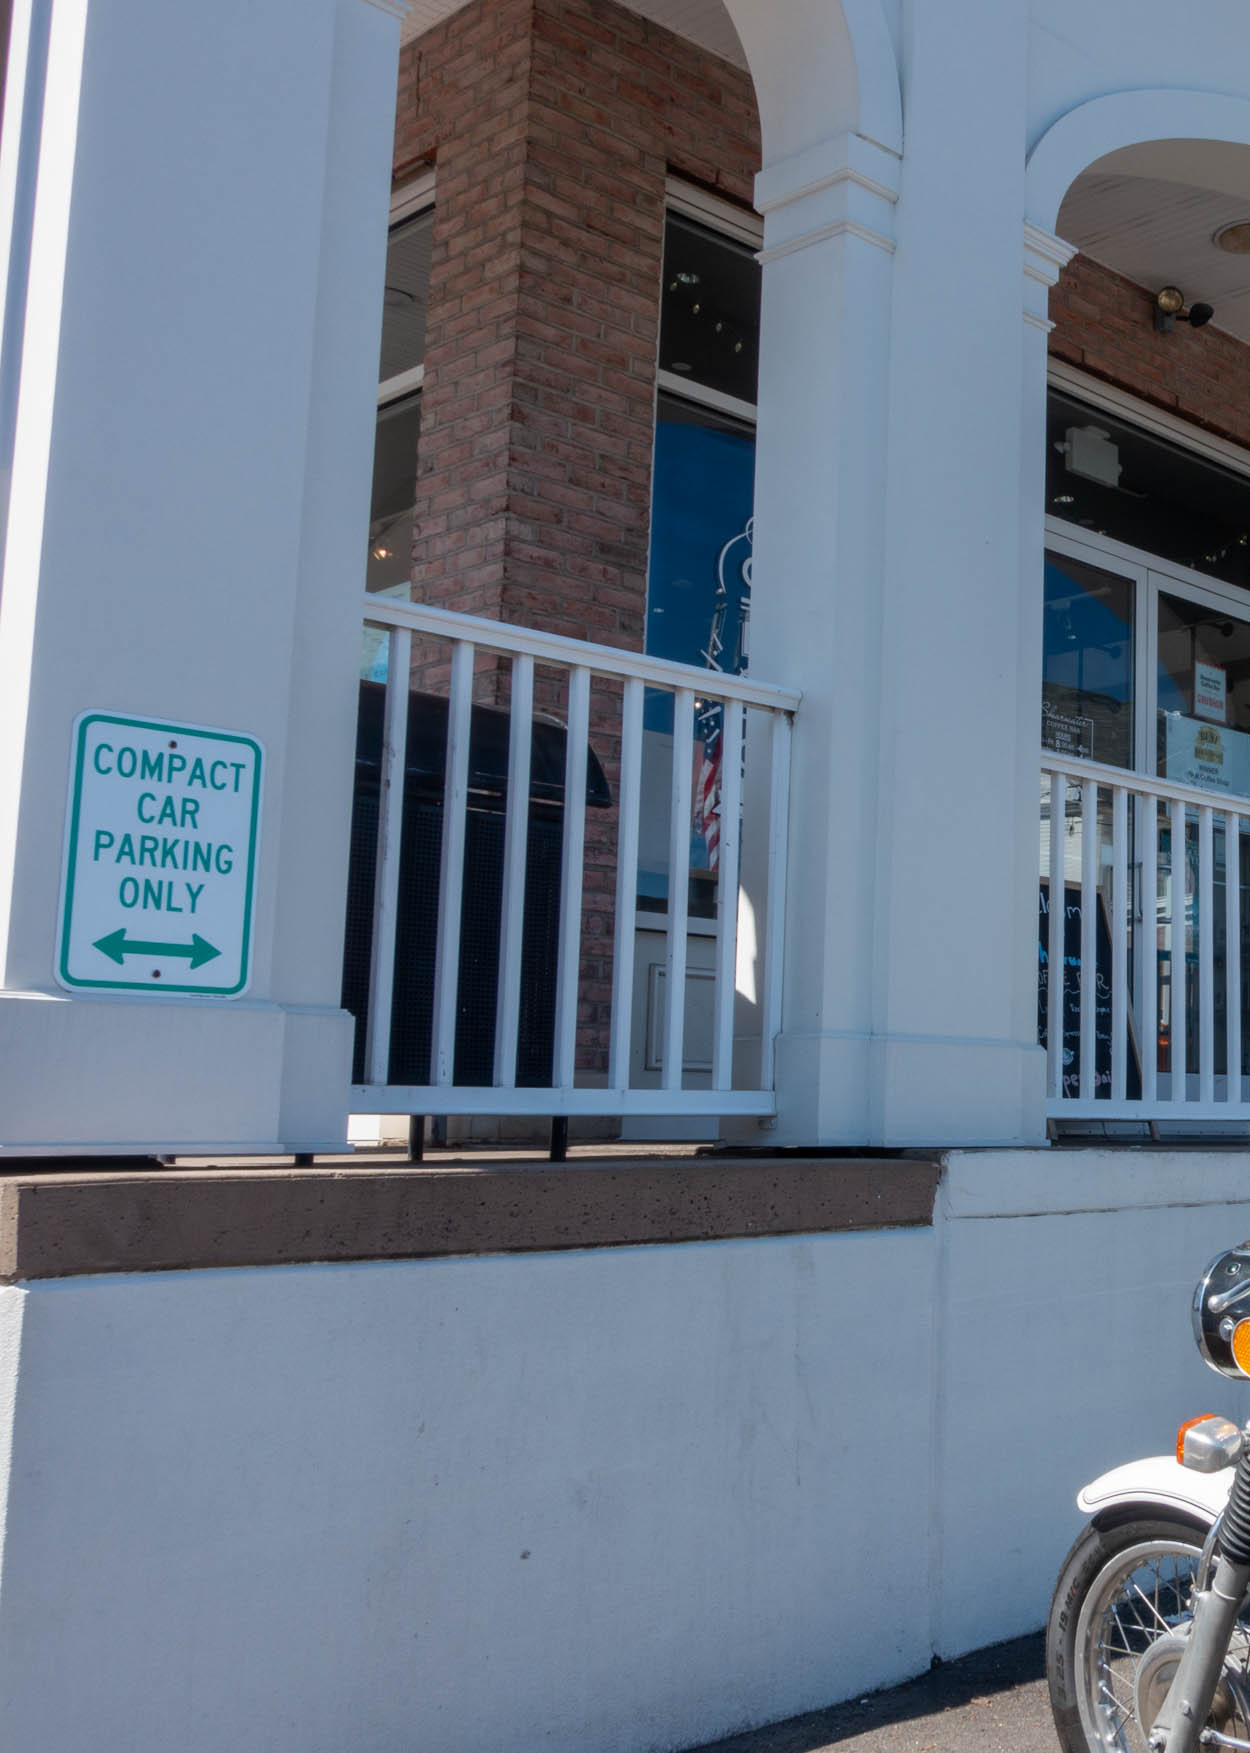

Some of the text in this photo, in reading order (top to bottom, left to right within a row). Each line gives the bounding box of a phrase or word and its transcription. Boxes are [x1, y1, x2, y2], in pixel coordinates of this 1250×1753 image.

[93, 743, 246, 793] COMPACT
[137, 792, 200, 830] CAR
[93, 830, 233, 875] PARKING
[119, 876, 205, 914] ONLY
